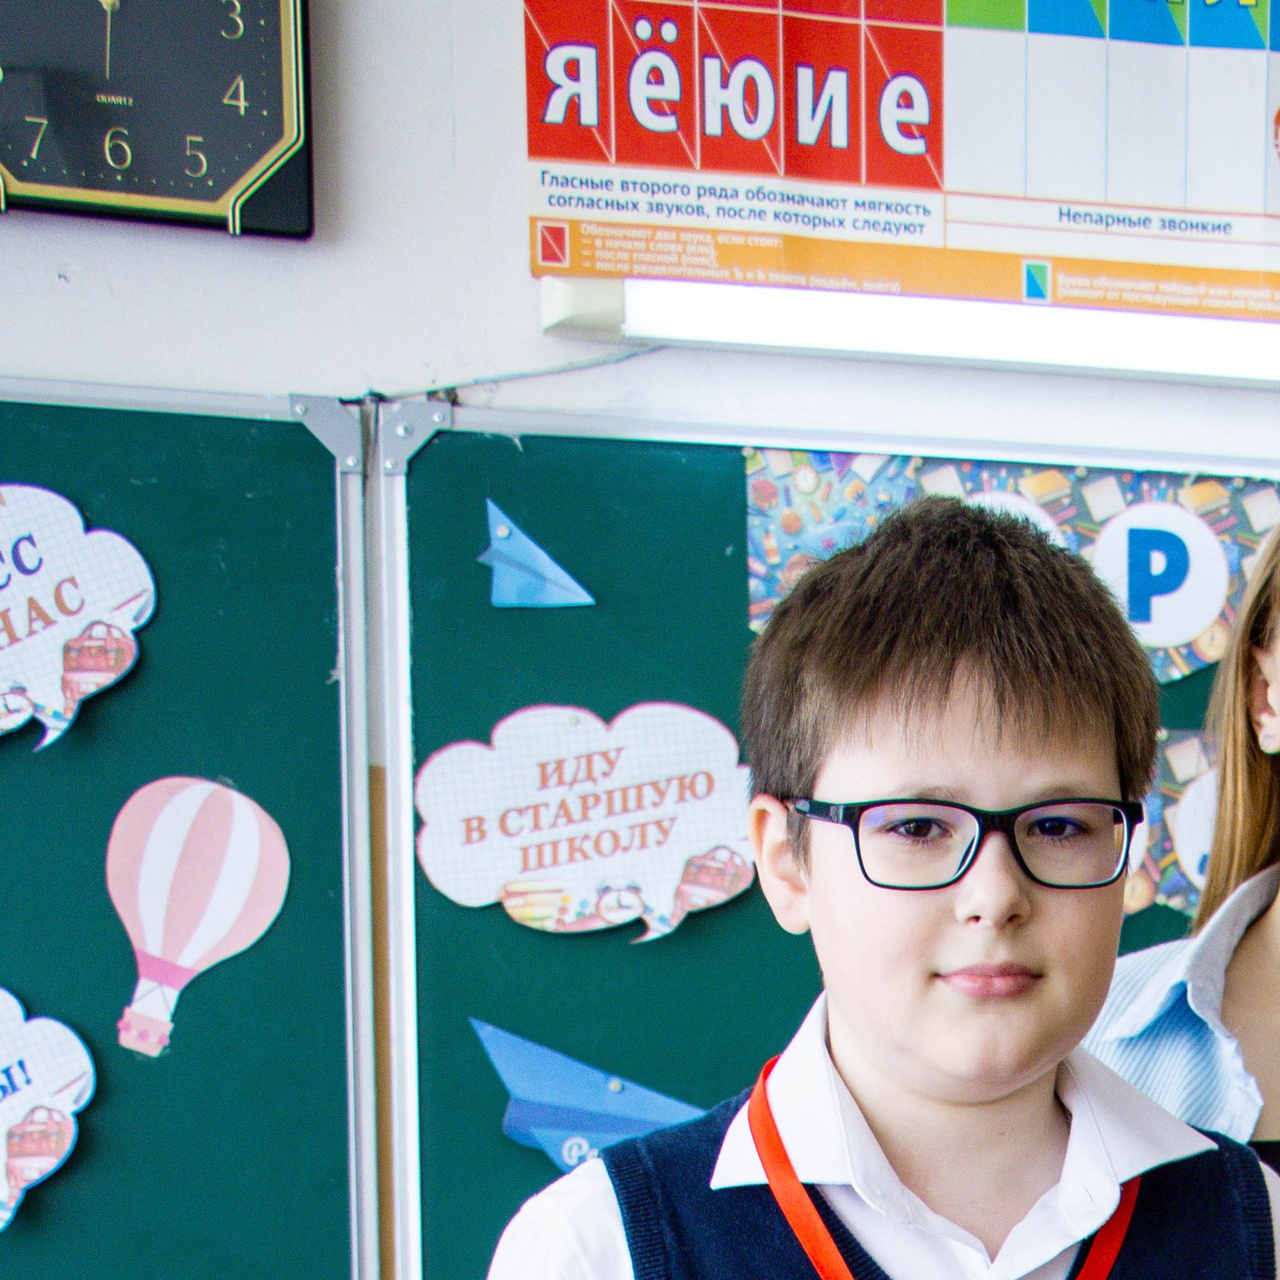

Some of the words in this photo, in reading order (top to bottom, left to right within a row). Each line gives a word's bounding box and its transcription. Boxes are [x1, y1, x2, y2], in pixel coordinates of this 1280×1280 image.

[221, 0, 244, 40] 3
[222, 74, 249, 116] 4
[25, 116, 48, 160] 7
[104, 127, 133, 170] 6
[184, 135, 208, 178] 5
[541, 170, 614, 191] Гласные
[621, 180, 691, 197] второго
[697, 185, 739, 201] ряда
[745, 186, 848, 211] обозначают
[855, 200, 932, 218] мягкость
[548, 194, 639, 212] согласных
[647, 201, 710, 219] звуков,
[717, 205, 767, 221] после
[774, 211, 845, 230] которых
[853, 219, 926, 237] следуют
[1058, 206, 1152, 231] Непарные
[1159, 219, 1232, 235] звонкие
[537, 747, 625, 790] ИДУ
[461, 816, 487, 846] В
[498, 770, 715, 836] СТАРШУЮ
[519, 817, 679, 874] ШКОЛУ
